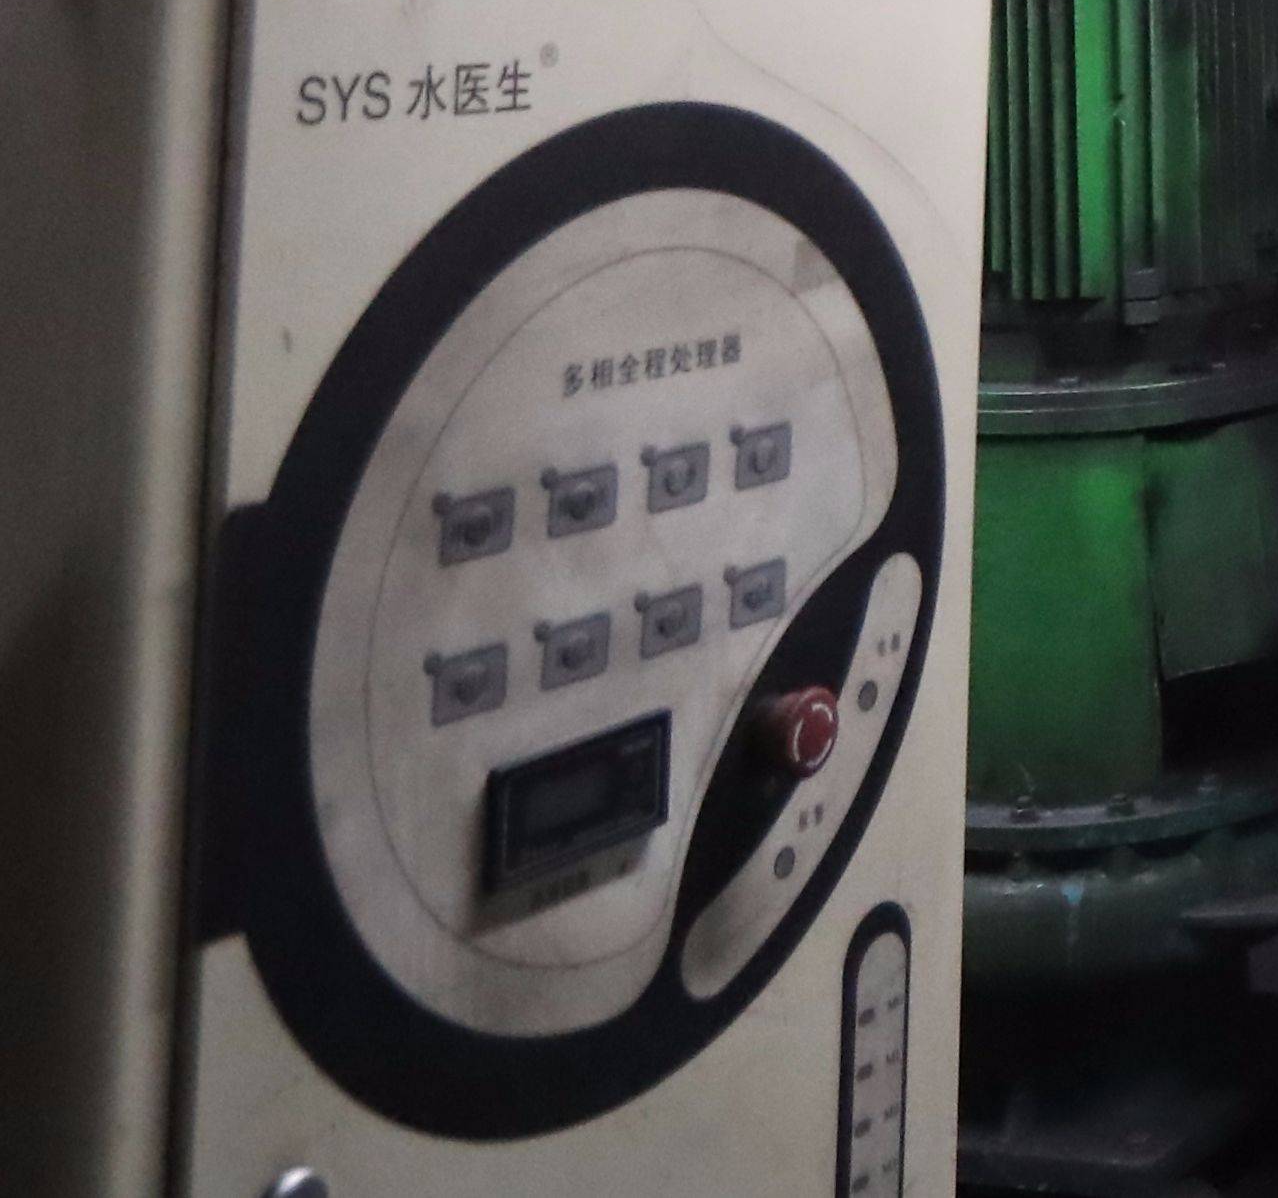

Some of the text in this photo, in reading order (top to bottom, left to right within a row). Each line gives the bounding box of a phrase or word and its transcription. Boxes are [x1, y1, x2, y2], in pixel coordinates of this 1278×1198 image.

[296, 59, 532, 126] SYS 水医生
[562, 334, 741, 398] 多相全程处理器
